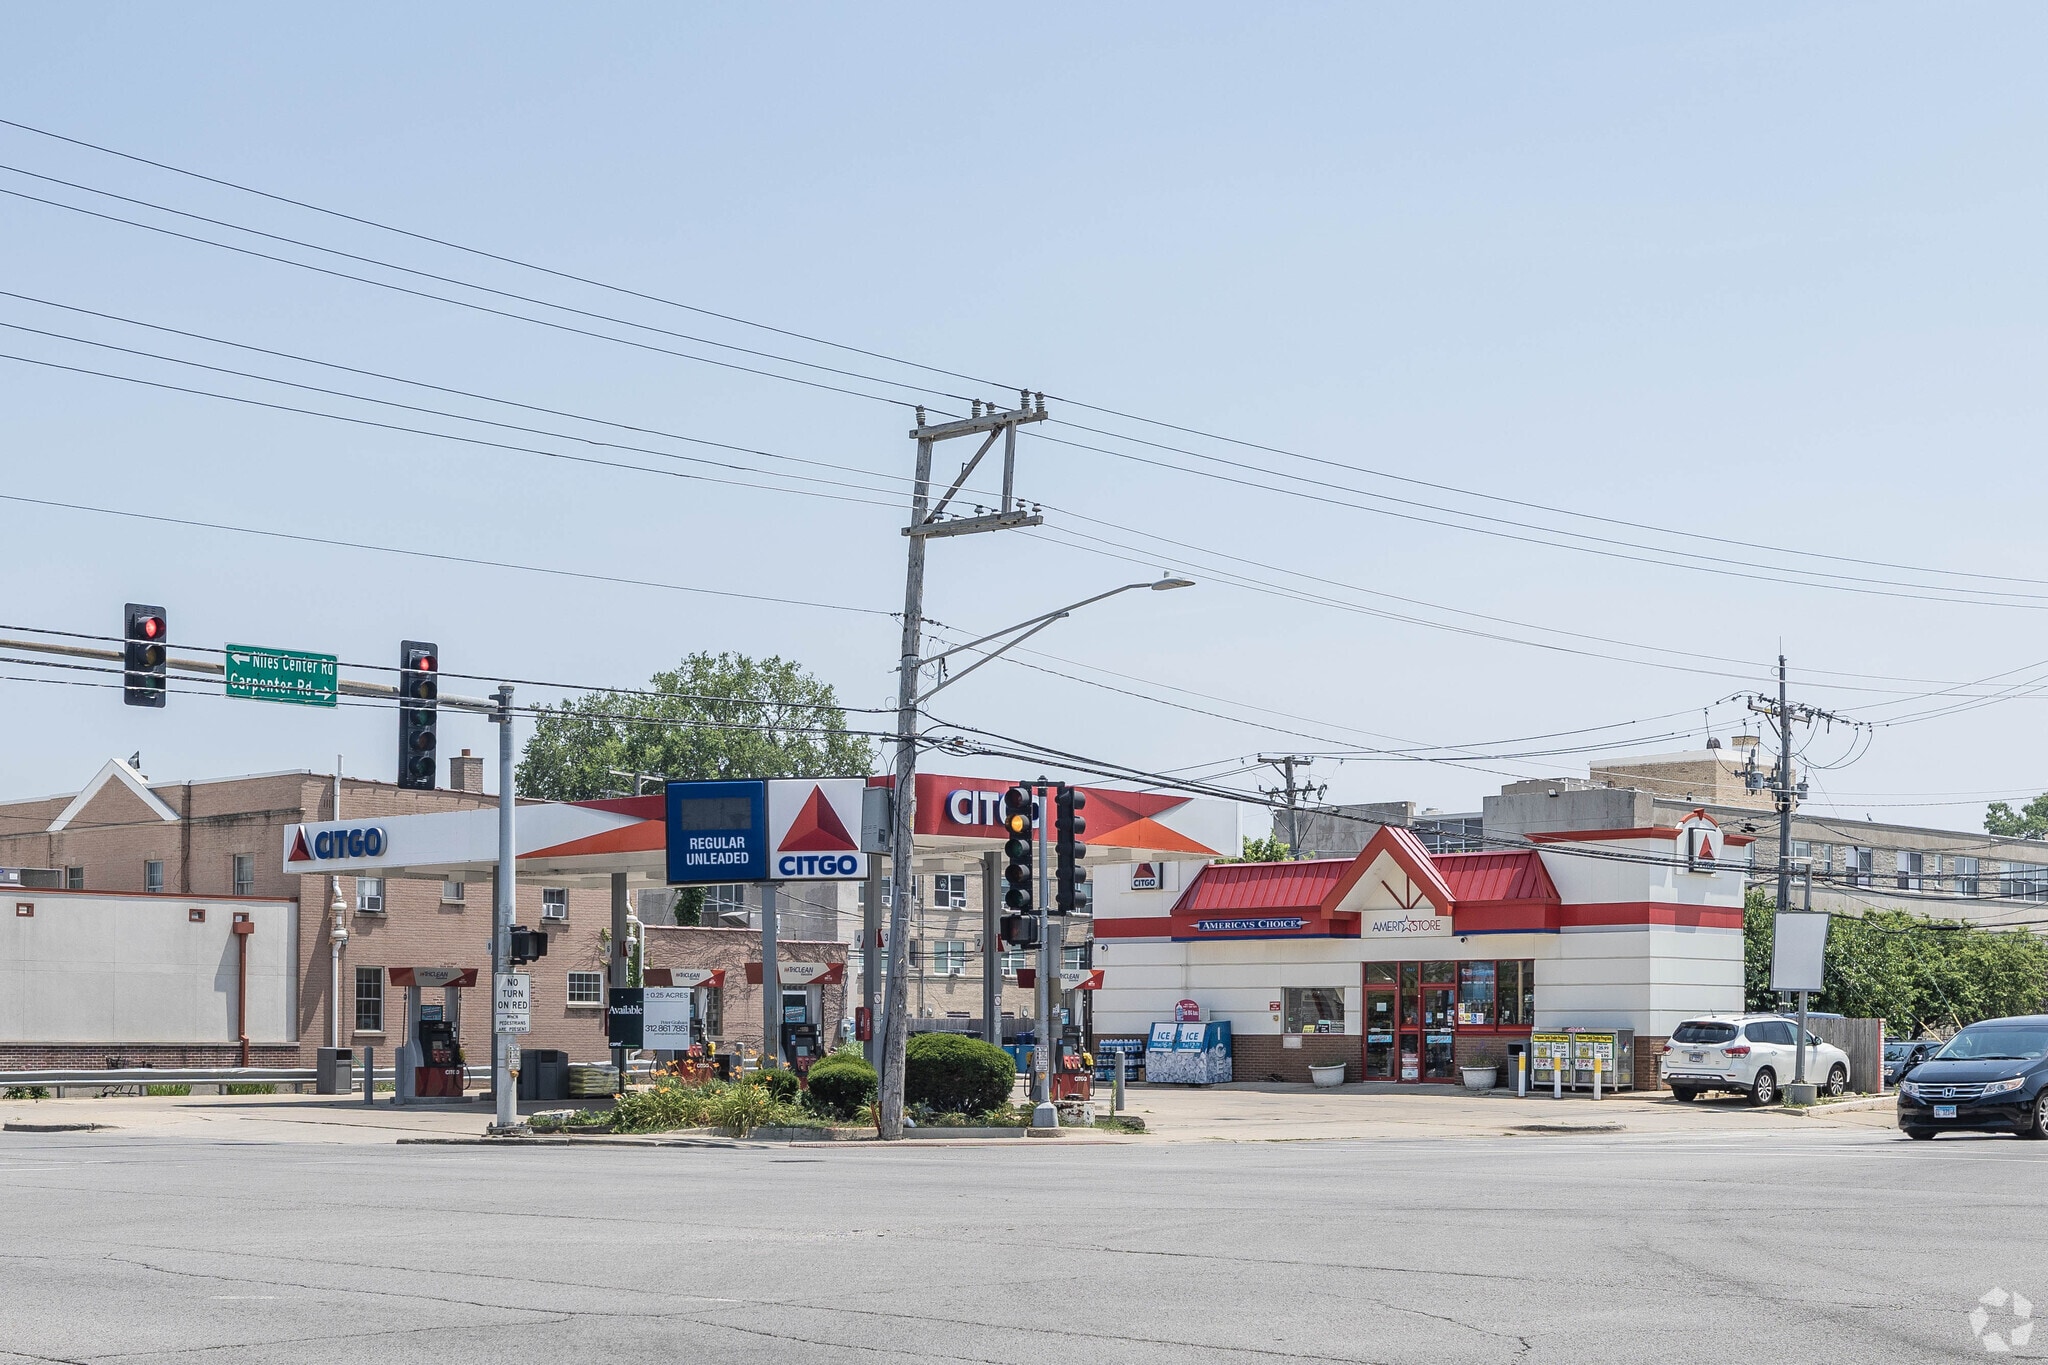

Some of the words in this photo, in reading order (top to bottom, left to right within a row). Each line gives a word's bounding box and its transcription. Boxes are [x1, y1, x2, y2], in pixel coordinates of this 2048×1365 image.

[253, 651, 279, 670] Niles
[282, 655, 317, 673] Center
[321, 658, 333, 676] Rd
[231, 673, 293, 695] Carpenter
[297, 679, 312, 696] Rd
[950, 789, 1040, 829] CIT
[314, 827, 382, 860] CITGO
[689, 836, 746, 850] REGULAR
[686, 852, 749, 866] UNLEADED
[778, 855, 858, 876] CITGO
[1133, 879, 1156, 887] CITGO
[1202, 921, 1255, 930] AMERICA'S
[1257, 920, 1297, 928] CHOICE
[507, 978, 519, 987] NO
[502, 989, 524, 998] TURN
[497, 1001, 509, 1009] ON
[512, 1001, 528, 1009] RED
[608, 1005, 643, 1015] Available
[645, 1024, 657, 1032] 312
[658, 1024, 671, 1032] 861
[671, 1024, 688, 1032] 7851
[1157, 1031, 1171, 1040] ICE
[1185, 1032, 1199, 1040] ICE
